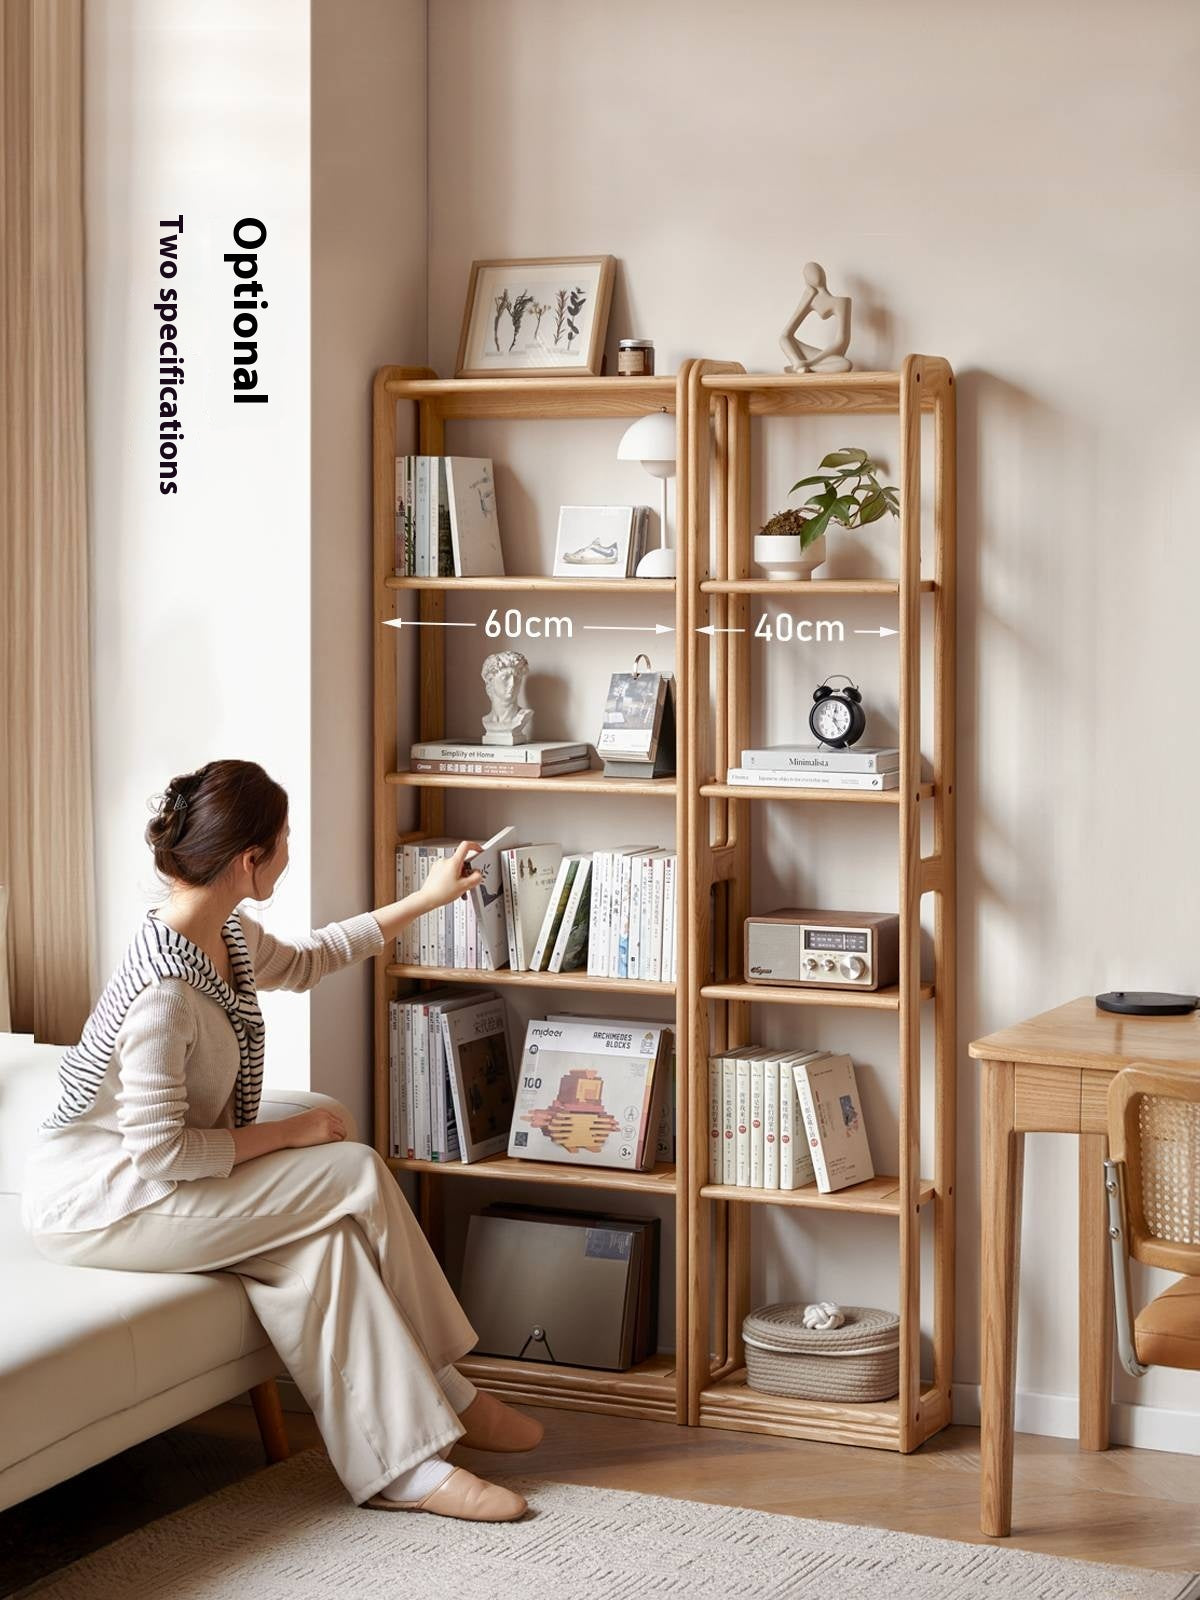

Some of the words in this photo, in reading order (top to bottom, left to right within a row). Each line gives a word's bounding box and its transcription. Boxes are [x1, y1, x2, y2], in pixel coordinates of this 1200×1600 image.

[788, 757, 829, 767] Minimalista
[531, 1027, 563, 1038] mideer
[592, 1030, 633, 1042] ARCHIMEDES
[605, 1040, 632, 1050] BLOCKS
[523, 1076, 543, 1090] 100
